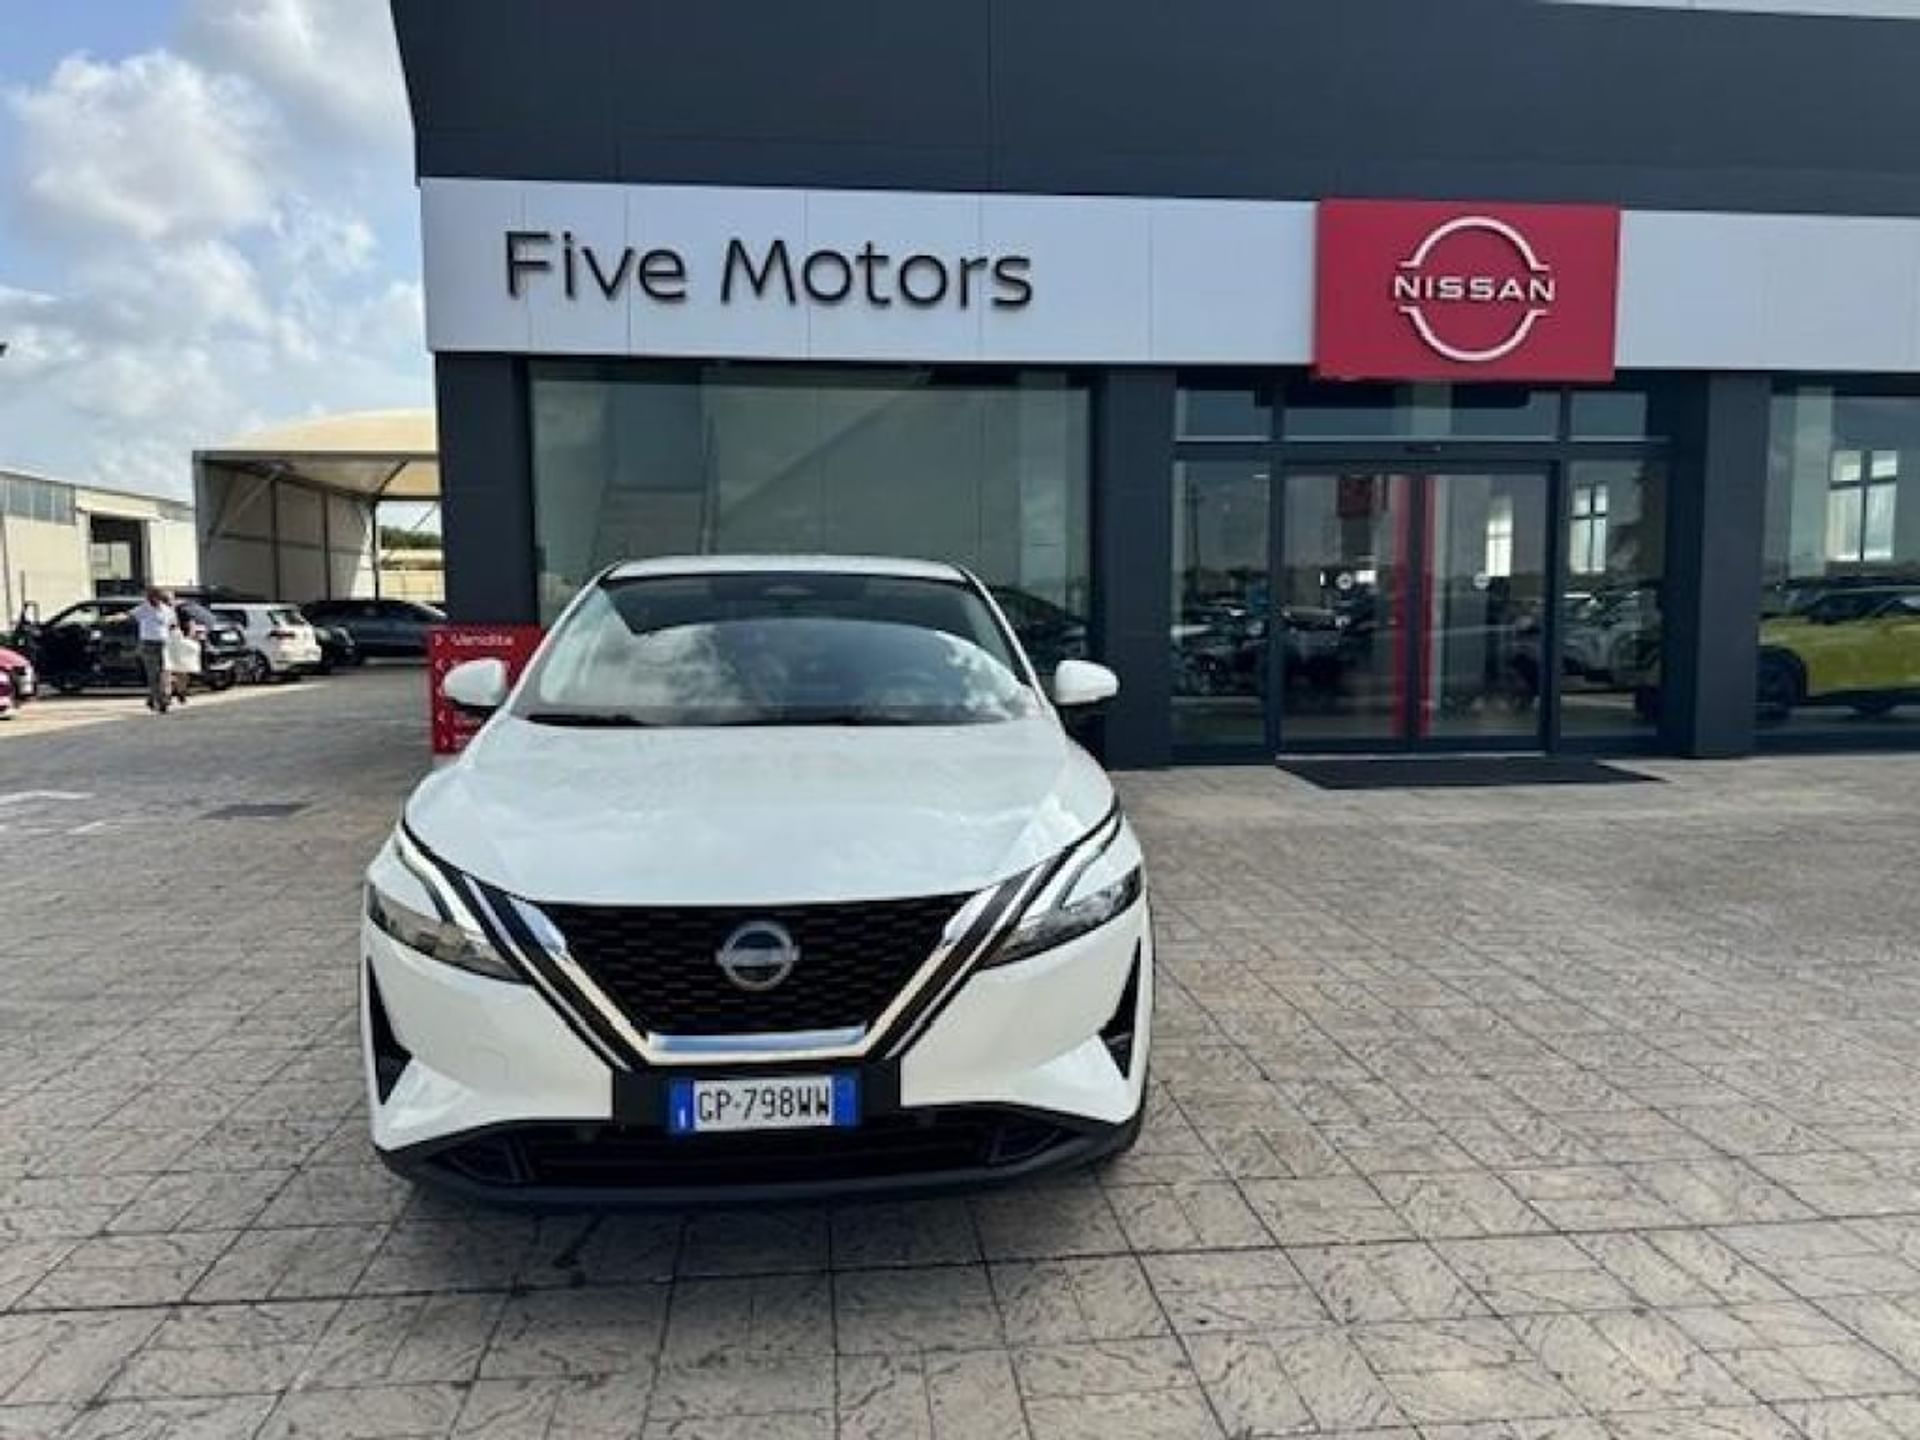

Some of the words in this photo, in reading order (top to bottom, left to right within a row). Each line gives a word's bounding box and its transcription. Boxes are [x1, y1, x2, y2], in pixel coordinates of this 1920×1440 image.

[504, 230, 687, 302] Five
[720, 237, 1035, 311] Motors
[1394, 275, 1556, 302] NISSAN
